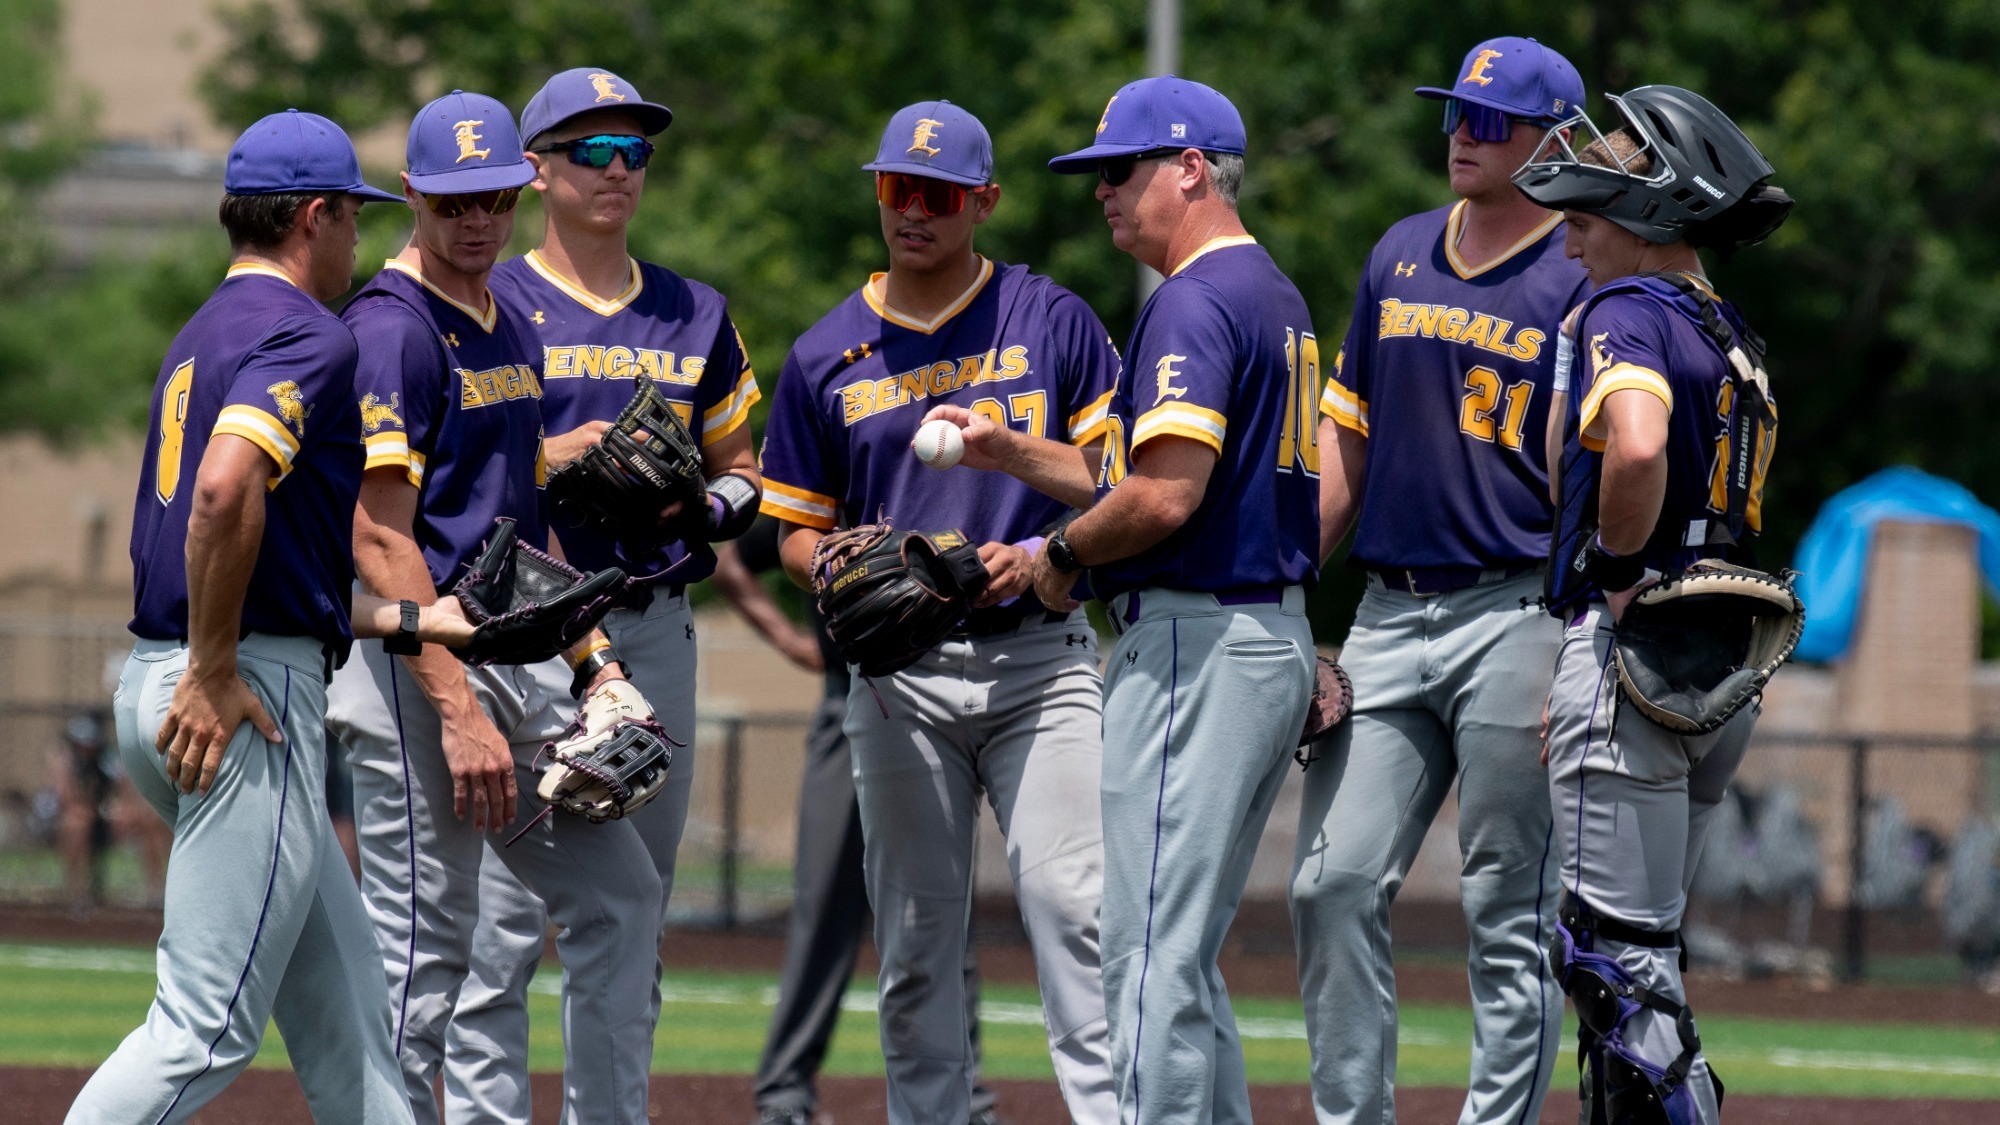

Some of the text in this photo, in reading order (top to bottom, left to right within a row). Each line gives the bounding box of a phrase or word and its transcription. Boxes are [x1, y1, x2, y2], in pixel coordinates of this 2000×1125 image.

[1462, 49, 1503, 87] E
[452, 119, 491, 164] E
[906, 118, 944, 156] E
[1692, 175, 1726, 199] marucci
[1378, 297, 1546, 362] BENGALS
[543, 345, 707, 386] ENGALS
[833, 345, 1029, 427] BENGALS
[1153, 353, 1188, 407] E
[1276, 326, 1321, 480] 10
[1460, 364, 1535, 452] 21
[156, 356, 195, 507] 8
[1736, 415, 1751, 490] marucci
[628, 453, 671, 490] marucci
[832, 562, 868, 594] marucci
